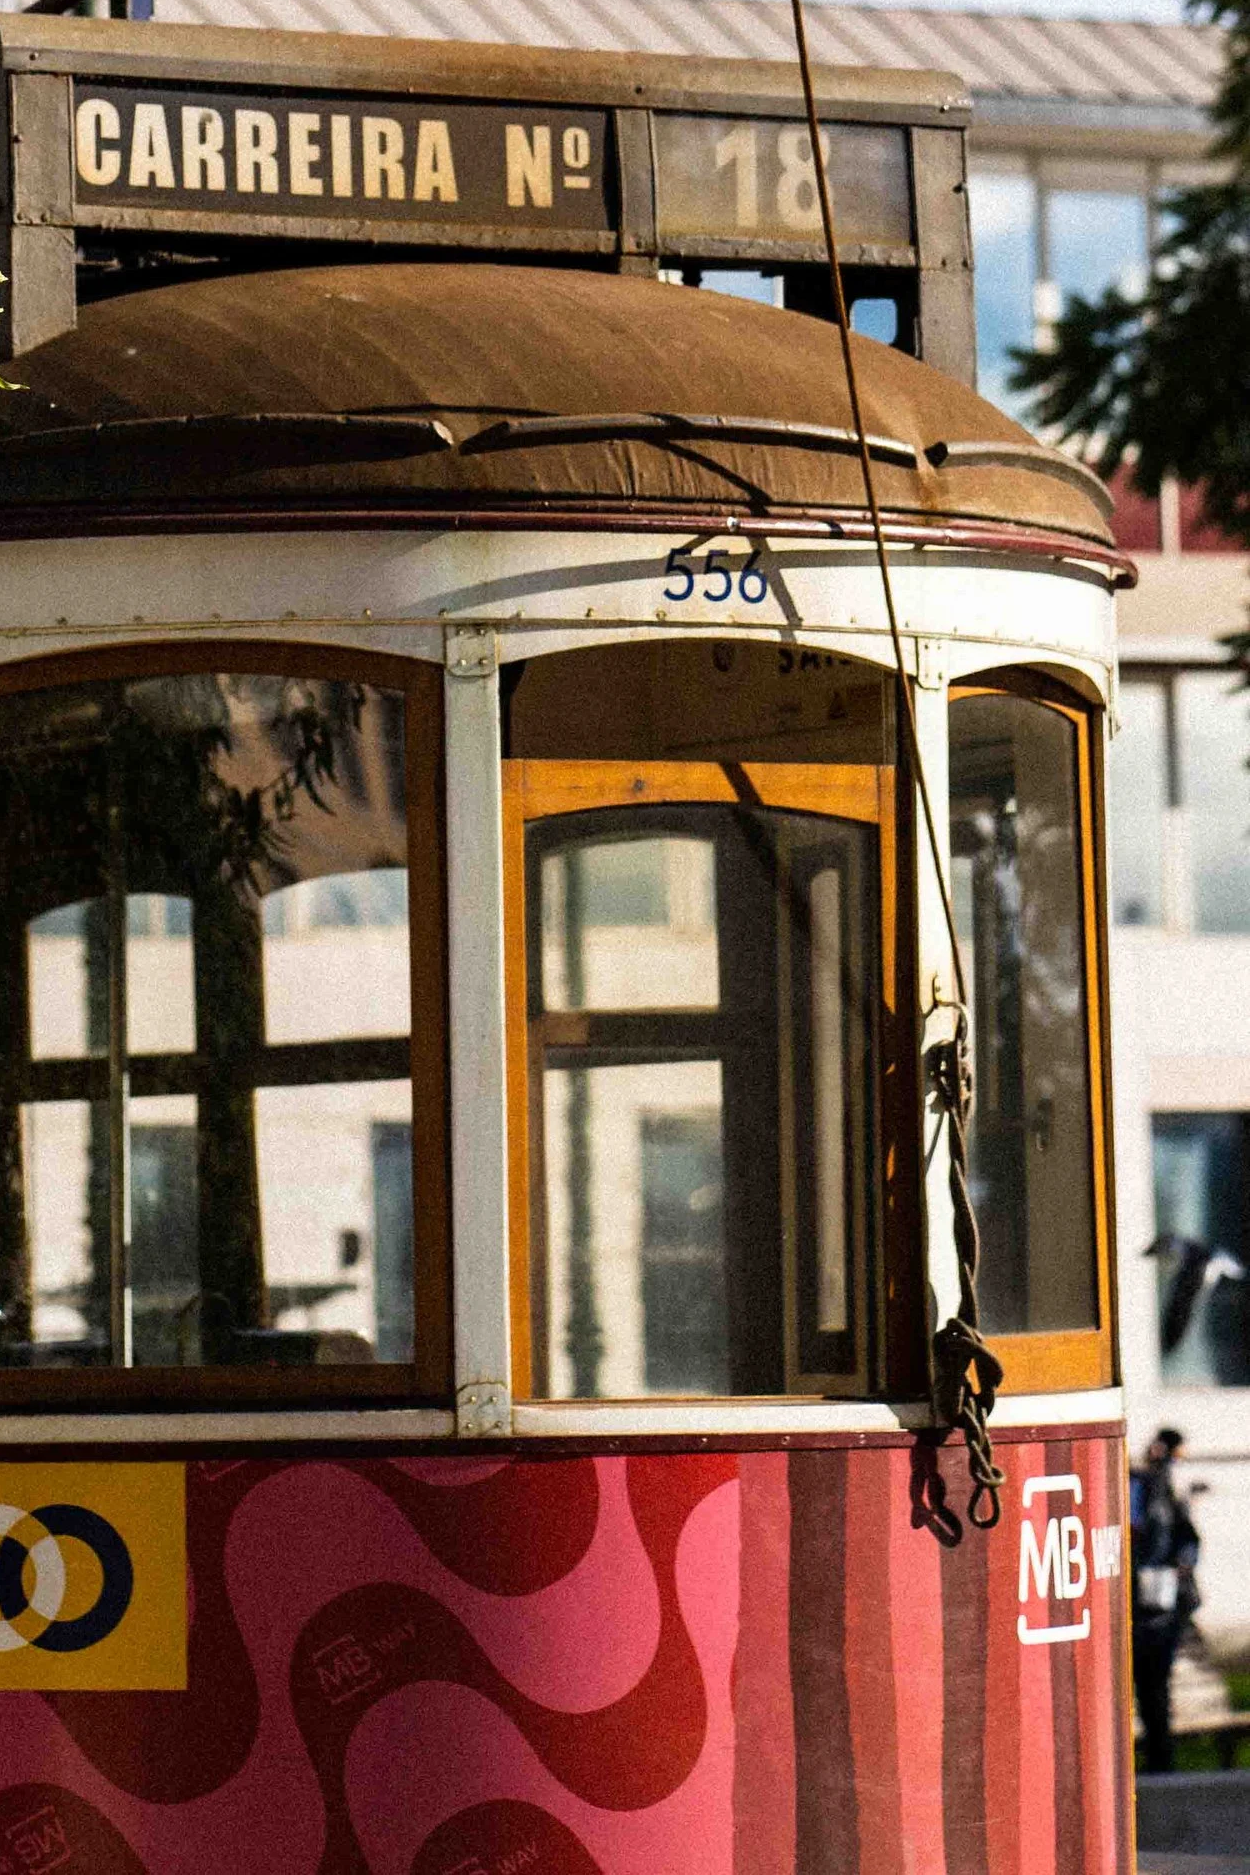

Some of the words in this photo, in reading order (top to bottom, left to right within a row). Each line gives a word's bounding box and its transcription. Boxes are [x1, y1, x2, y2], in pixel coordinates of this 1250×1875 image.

[75, 98, 459, 203] CARREIRA
[716, 124, 836, 231] 18
[663, 548, 768, 604] 556
[1018, 1515, 1088, 1604] MB
